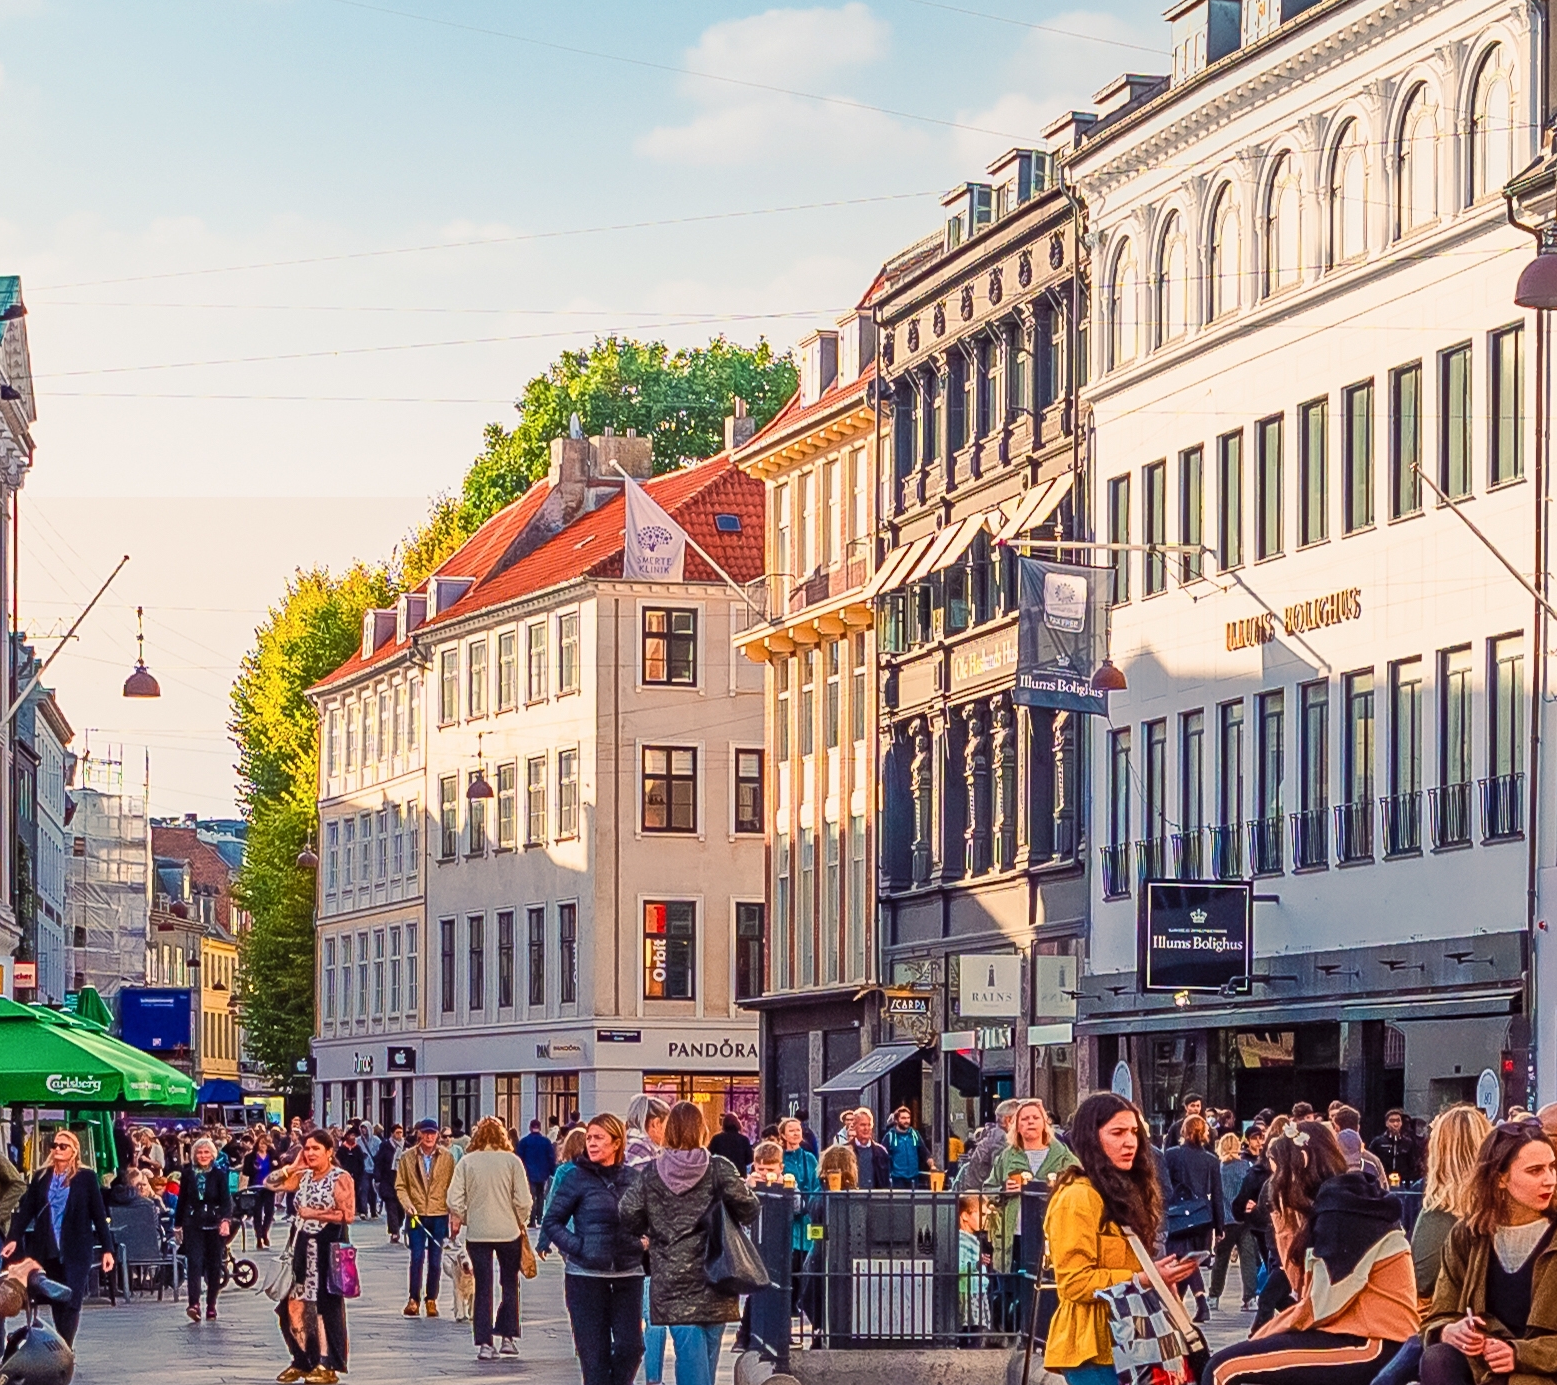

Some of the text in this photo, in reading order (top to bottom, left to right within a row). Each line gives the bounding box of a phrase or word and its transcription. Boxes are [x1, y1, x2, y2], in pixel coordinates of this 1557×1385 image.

[637, 555, 673, 565] SMERTE
[639, 565, 670, 574] KLINIK
[1226, 587, 1361, 652] ILLUMS BOLIGHUS
[1019, 674, 1055, 691] Illums
[1152, 934, 1243, 953] Illums Bolighus
[652, 938, 667, 983] Orbit
[890, 999, 927, 1011] SCARPA
[971, 991, 1013, 1003] RAINS
[45, 1073, 102, 1096] Carlsberg
